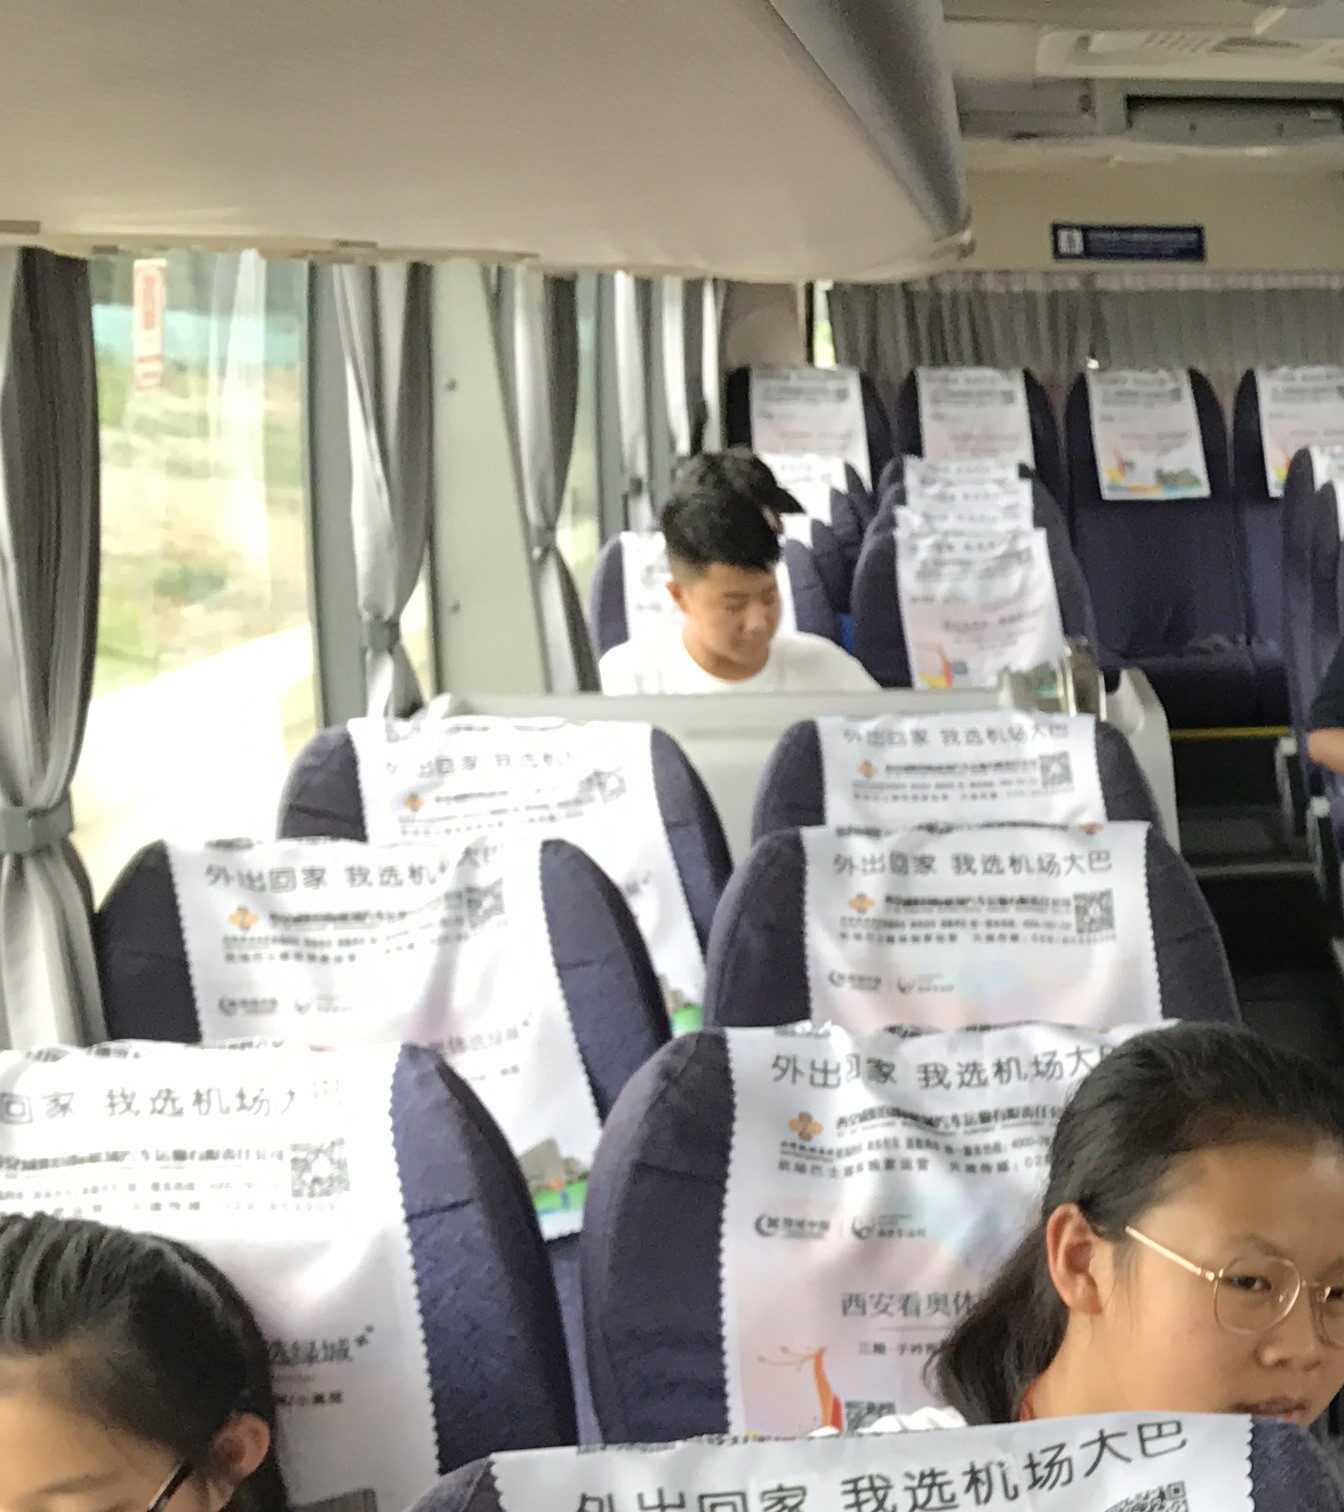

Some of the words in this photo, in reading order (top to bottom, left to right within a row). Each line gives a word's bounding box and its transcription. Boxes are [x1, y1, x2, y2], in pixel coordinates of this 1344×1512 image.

[833, 851, 936, 876] 外出回家
[951, 849, 1112, 877] 我选机场大巴
[206, 864, 326, 892] 外出回家
[917, 1044, 1110, 1090] 我选机场大
